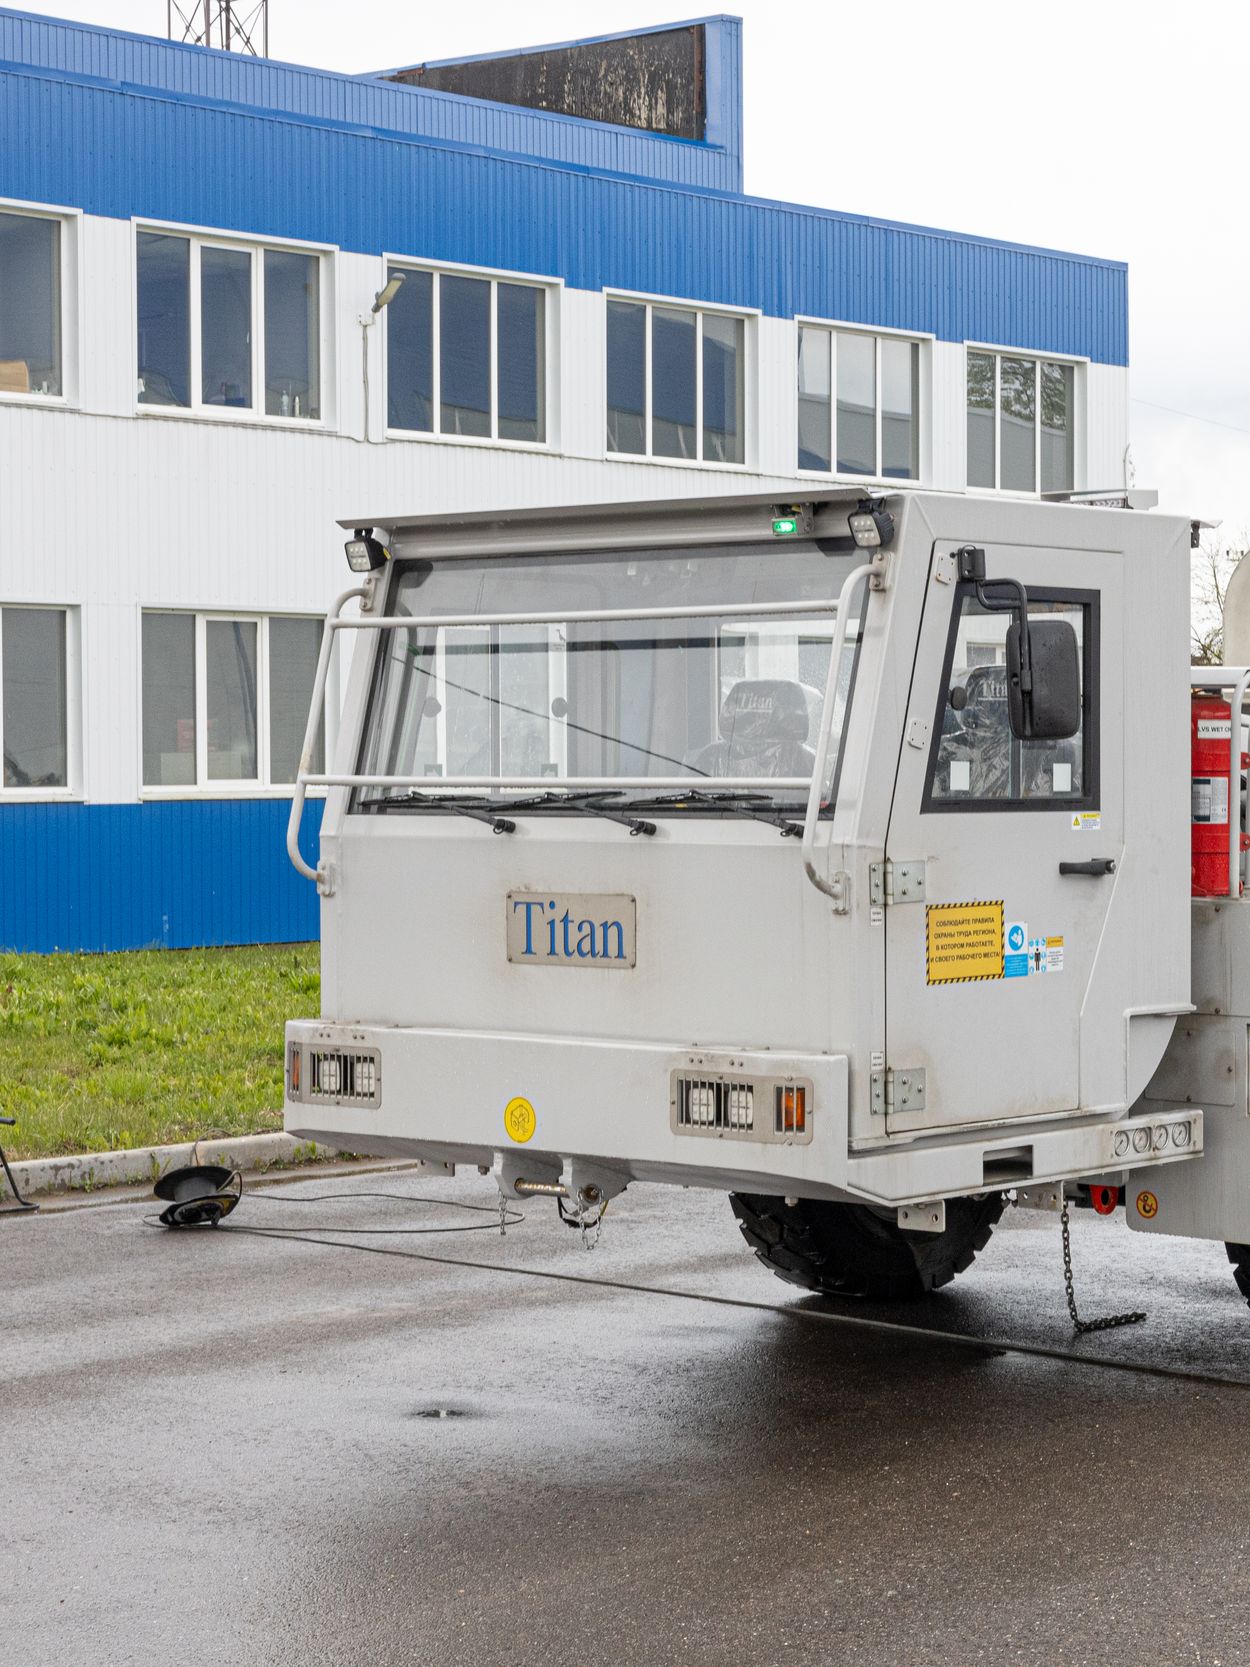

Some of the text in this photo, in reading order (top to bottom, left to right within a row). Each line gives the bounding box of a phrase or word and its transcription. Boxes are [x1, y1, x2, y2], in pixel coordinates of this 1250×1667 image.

[935, 916, 995, 928] СОБЛЮДАЙТЕ ПРАВИЛА
[513, 899, 628, 960] Titan
[933, 931, 956, 940] ОХРАНЫ
[956, 930, 972, 938] ТРУДА
[940, 941, 965, 951] КОТОРОМ
[935, 954, 955, 963] СВОЕГО
[956, 952, 982, 961] РАБОЧЕГО
